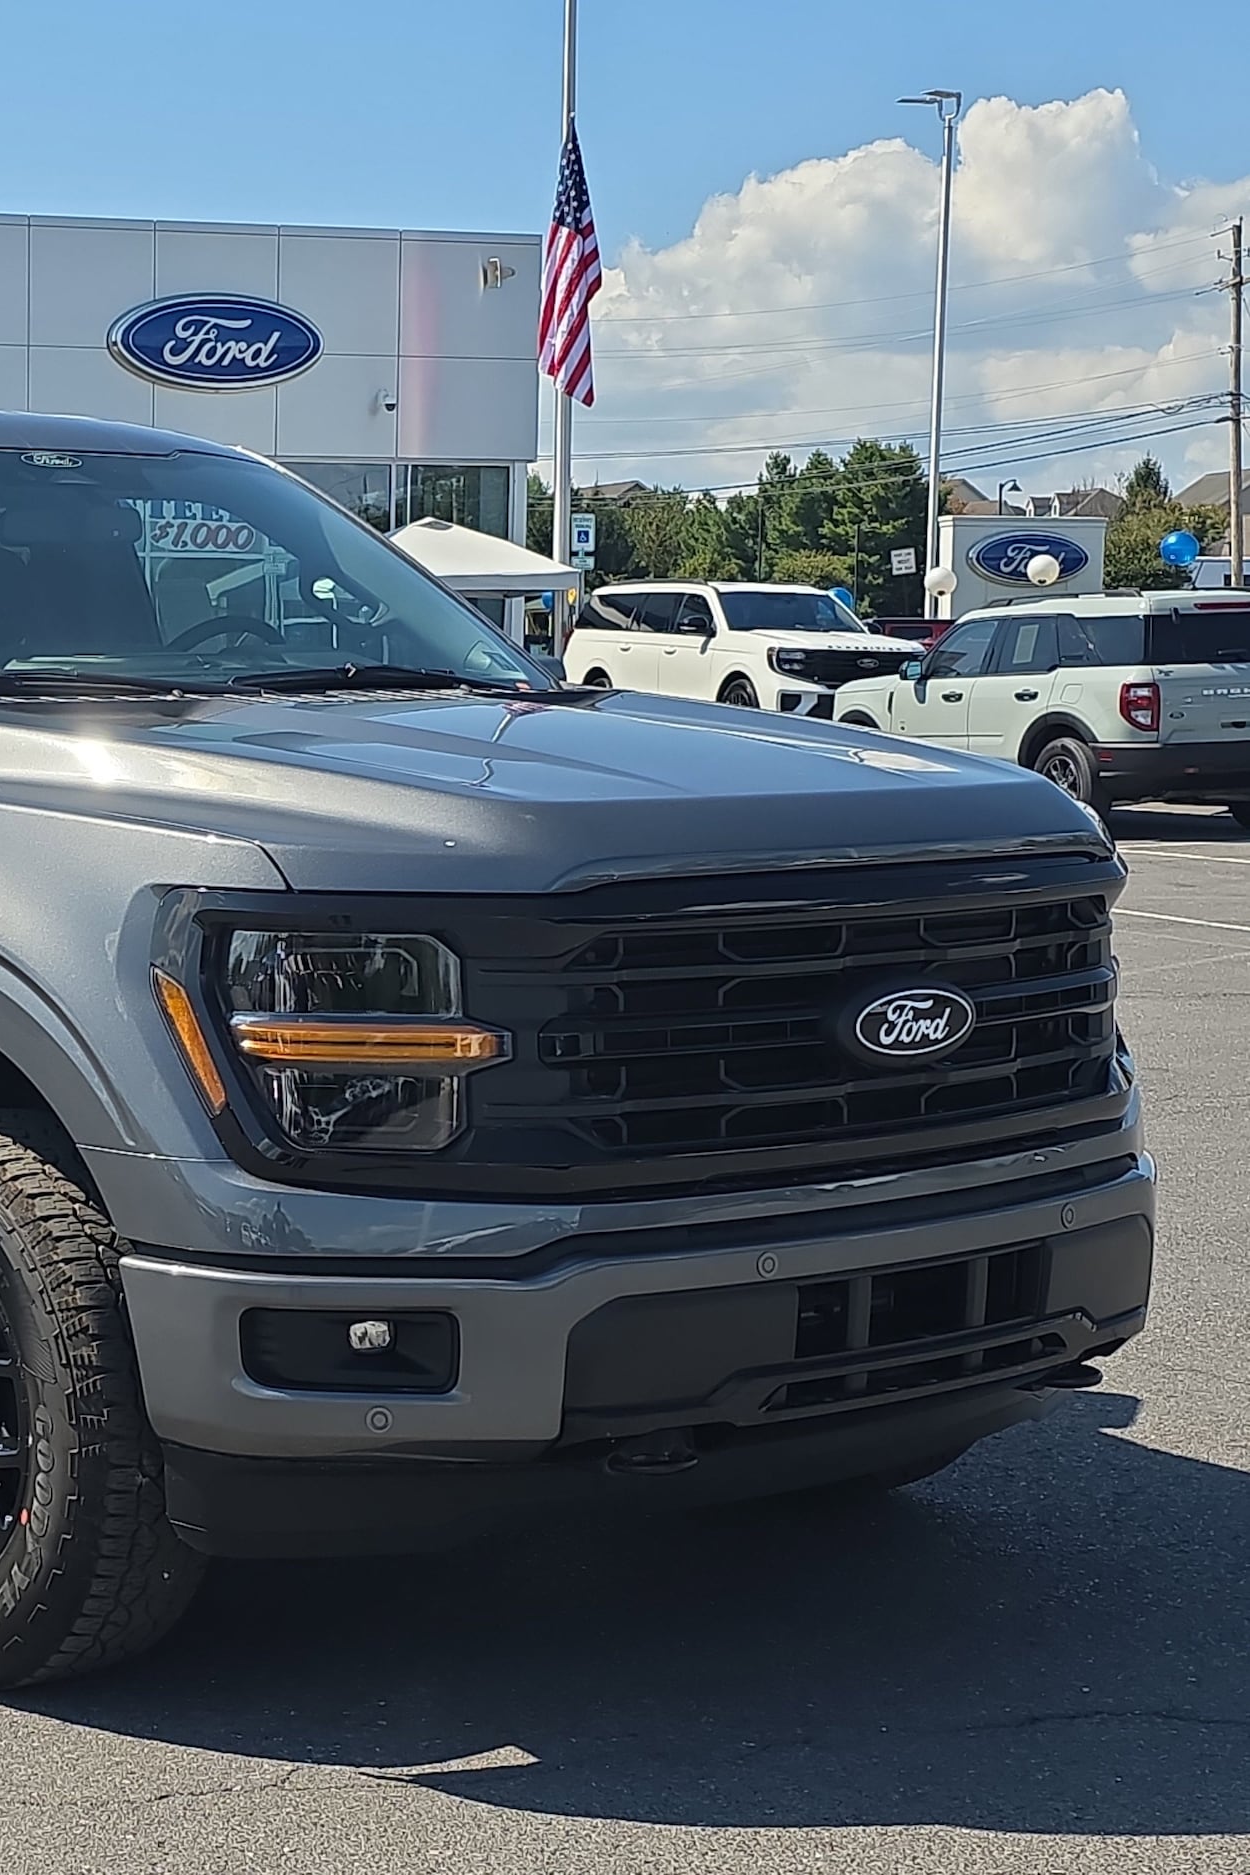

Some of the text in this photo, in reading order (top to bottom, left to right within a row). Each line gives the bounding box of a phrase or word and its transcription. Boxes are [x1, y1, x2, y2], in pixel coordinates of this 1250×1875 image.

[162, 315, 282, 368] Ford
[151, 520, 255, 550] $1,000
[879, 999, 951, 1045] Ford
